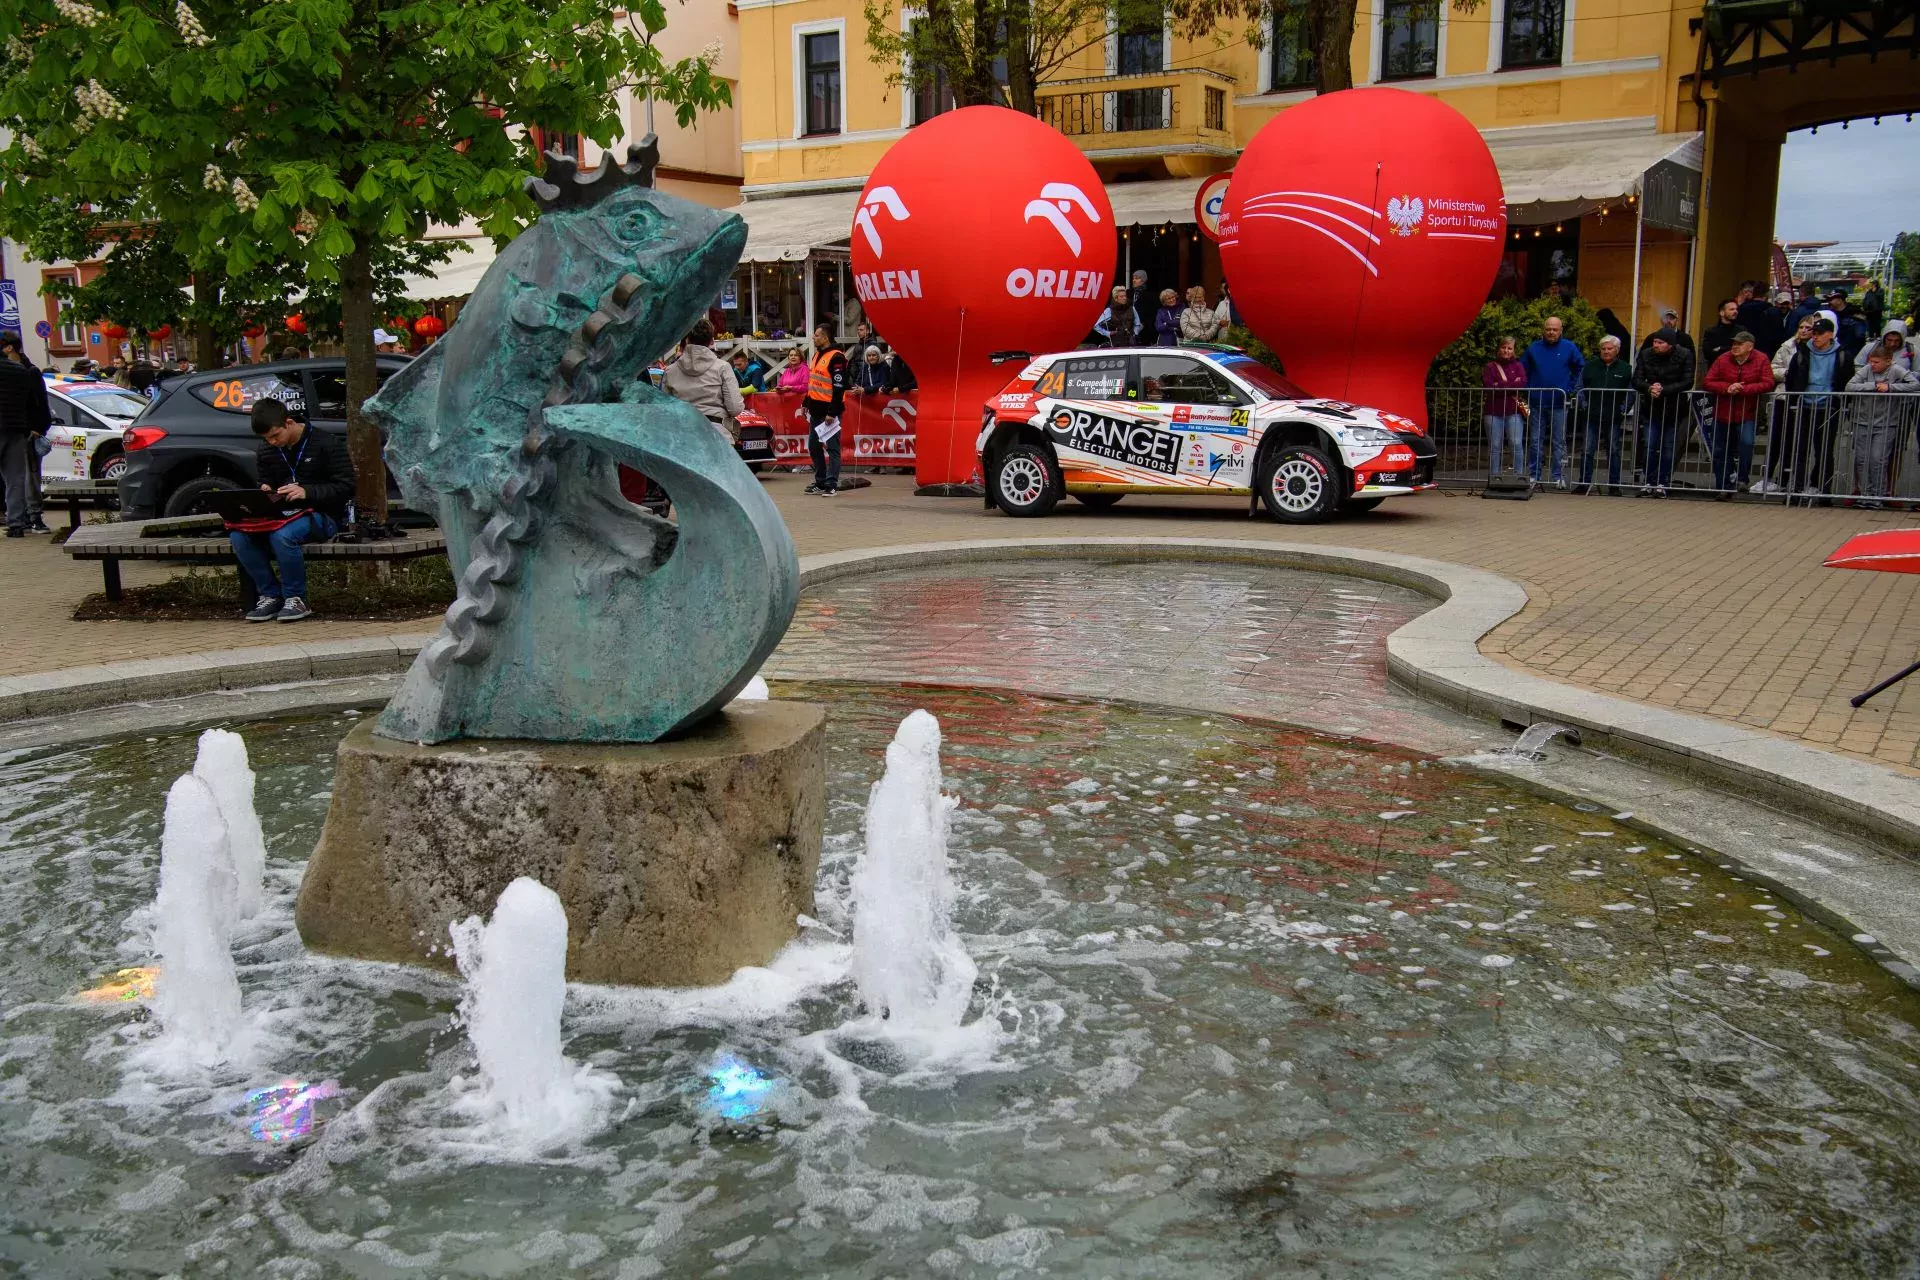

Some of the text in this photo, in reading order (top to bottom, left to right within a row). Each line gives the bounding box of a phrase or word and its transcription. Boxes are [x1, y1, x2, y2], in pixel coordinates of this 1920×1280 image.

[1428, 198, 1485, 213] Ministerstwo
[1427, 214, 1462, 228] Sportu
[1467, 215, 1498, 231] Turystyki
[855, 269, 923, 302] ORLEN
[1006, 268, 1103, 300] ORLEN
[1041, 372, 1065, 395] 24
[1067, 379, 1114, 388] S. Campedelli
[213, 380, 243, 408] 26
[999, 393, 1033, 402] MRF
[1191, 414, 1207, 422] Rally
[1207, 414, 1229, 422] Poland
[1229, 409, 1249, 427] 24
[73, 436, 85, 450] 25
[1049, 408, 1180, 463] ORANGE1
[775, 438, 809, 454] ORL
[1069, 438, 1174, 473] ELECTRIC MOTORS
[1387, 453, 1412, 462] MRF
